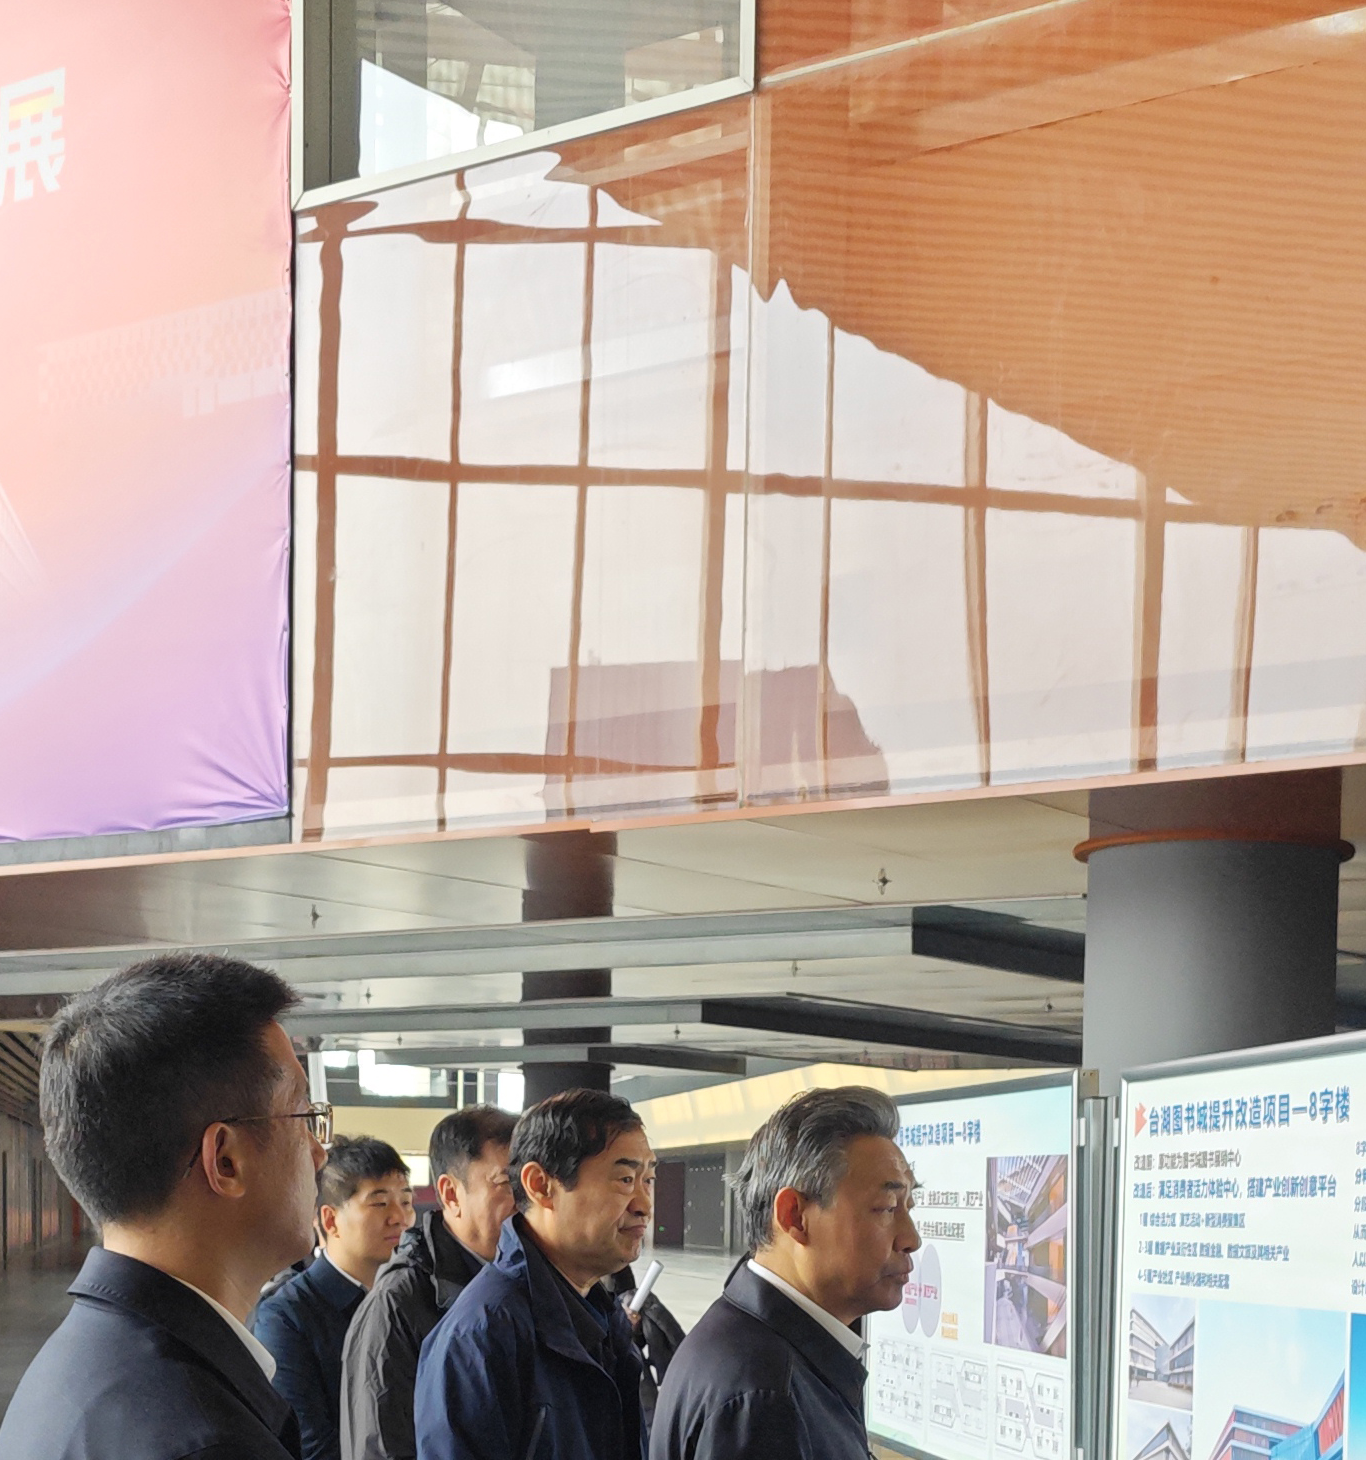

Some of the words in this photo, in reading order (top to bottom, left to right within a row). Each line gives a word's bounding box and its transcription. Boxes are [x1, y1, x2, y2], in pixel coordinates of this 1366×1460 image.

[1148, 1085, 1351, 1138] 台湖图书城提升改造项目—8字楼
